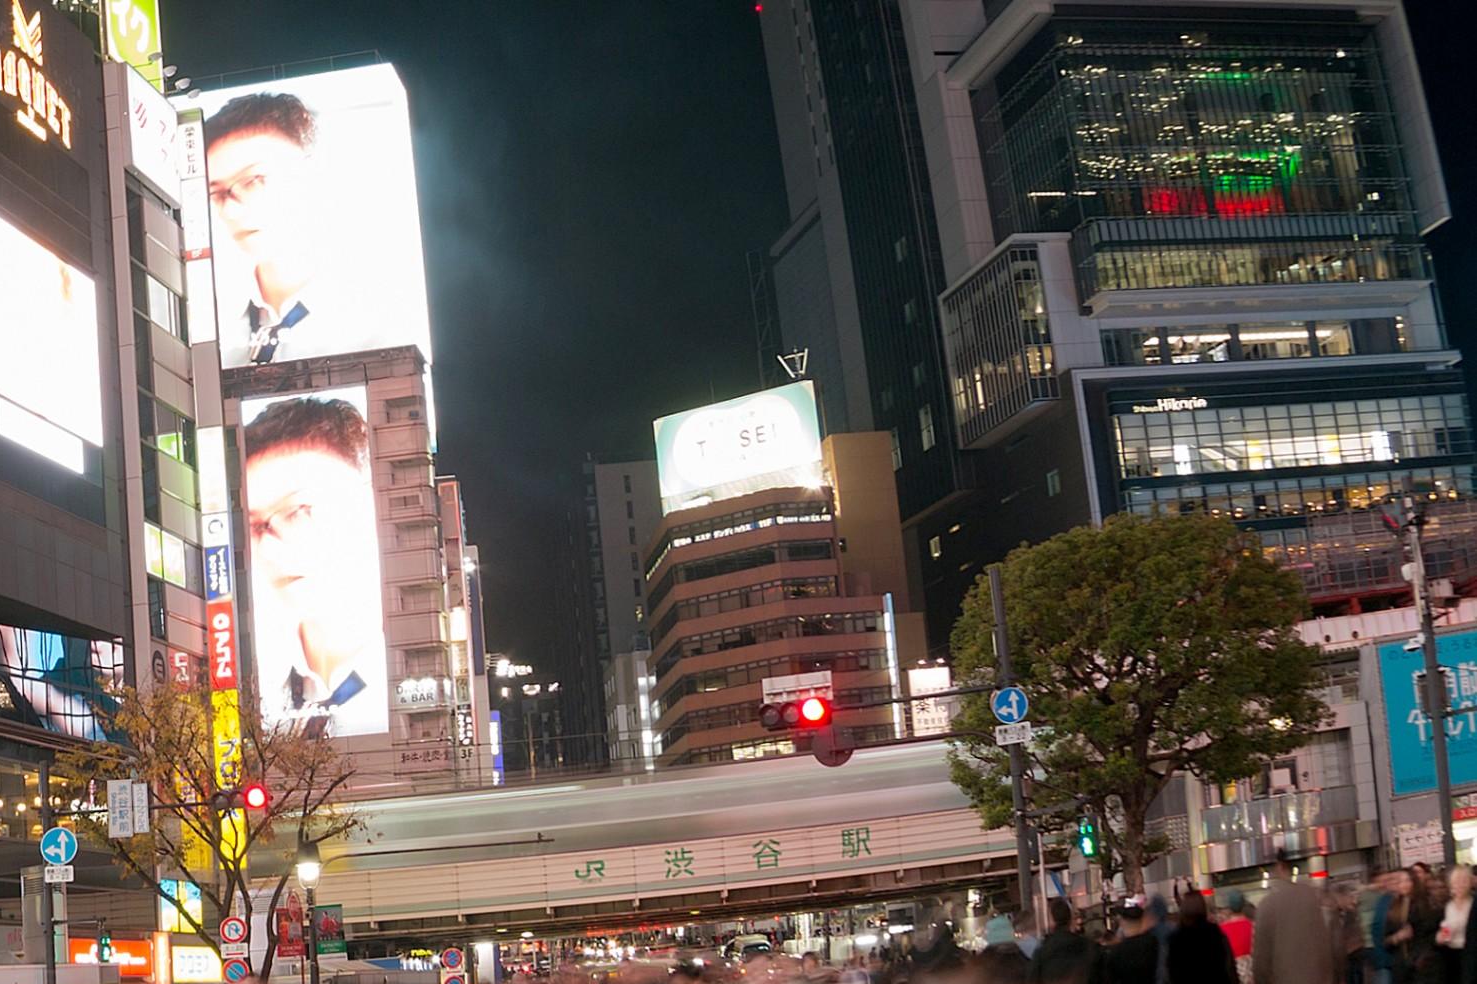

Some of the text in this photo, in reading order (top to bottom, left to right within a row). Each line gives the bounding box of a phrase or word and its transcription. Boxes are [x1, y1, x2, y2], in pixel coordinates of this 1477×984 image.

[1157, 396, 1208, 411] Hikarie
[411, 692, 434, 703] BAR
[460, 748, 473, 759] 3F
[575, 860, 605, 880] JR
